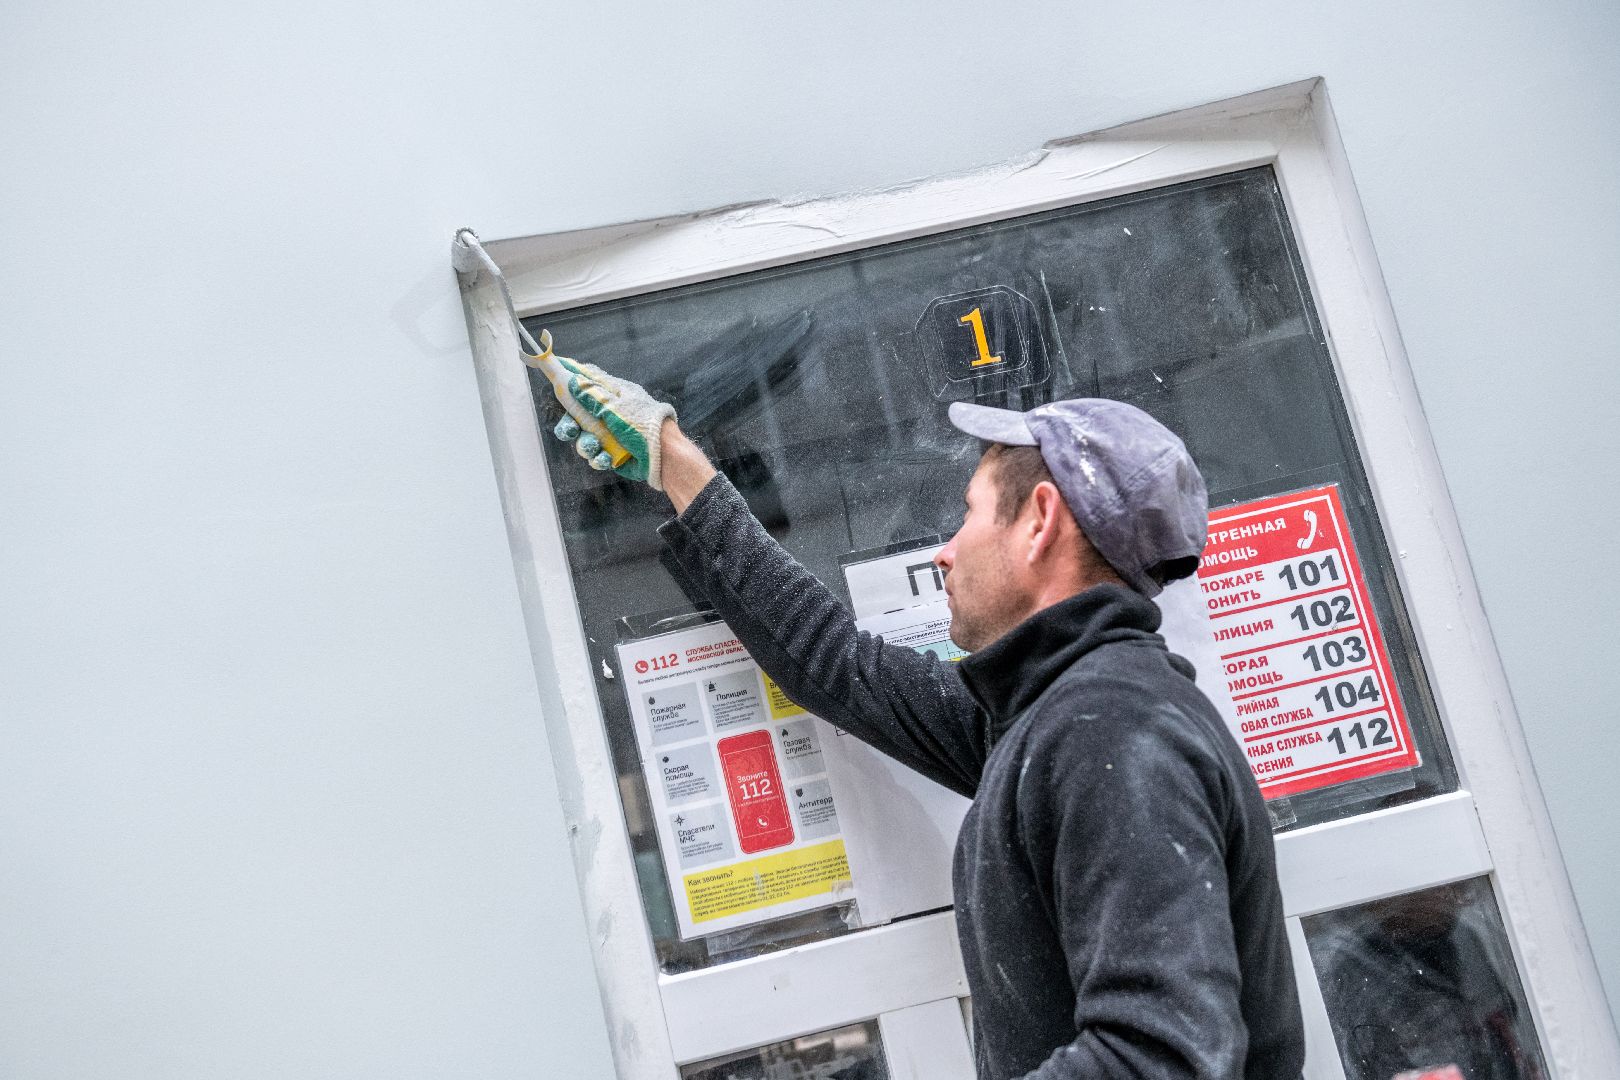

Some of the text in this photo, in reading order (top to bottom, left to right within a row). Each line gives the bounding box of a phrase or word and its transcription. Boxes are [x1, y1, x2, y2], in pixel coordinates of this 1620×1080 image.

[960, 307, 1001, 367] 1
[1205, 517, 1287, 546] ТРЕННАЯ
[906, 561, 946, 596] П
[1278, 554, 1340, 591] 101
[1290, 595, 1355, 631] 102
[651, 653, 679, 671] 112
[1302, 636, 1367, 672] 103
[1223, 655, 1269, 676] ОРАЯ
[716, 689, 748, 702] Полиция
[1314, 675, 1380, 713] 104
[650, 703, 686, 716] Пожарная
[1236, 696, 1280, 717] РИЙНАЯ
[652, 711, 679, 723] служба
[1270, 707, 1314, 727] СЛУЖБА
[783, 736, 811, 748] Газовая
[1277, 731, 1323, 751] СЛУЖБА
[1327, 717, 1393, 755] 112
[785, 744, 812, 756] служба
[664, 764, 689, 775] Скорая
[665, 771, 694, 782] помощь
[736, 770, 768, 783] Звоните
[740, 778, 773, 800] 112
[678, 824, 715, 837] Спасатели
[680, 834, 696, 845] МЧС
[687, 869, 734, 886] Как звонить?
